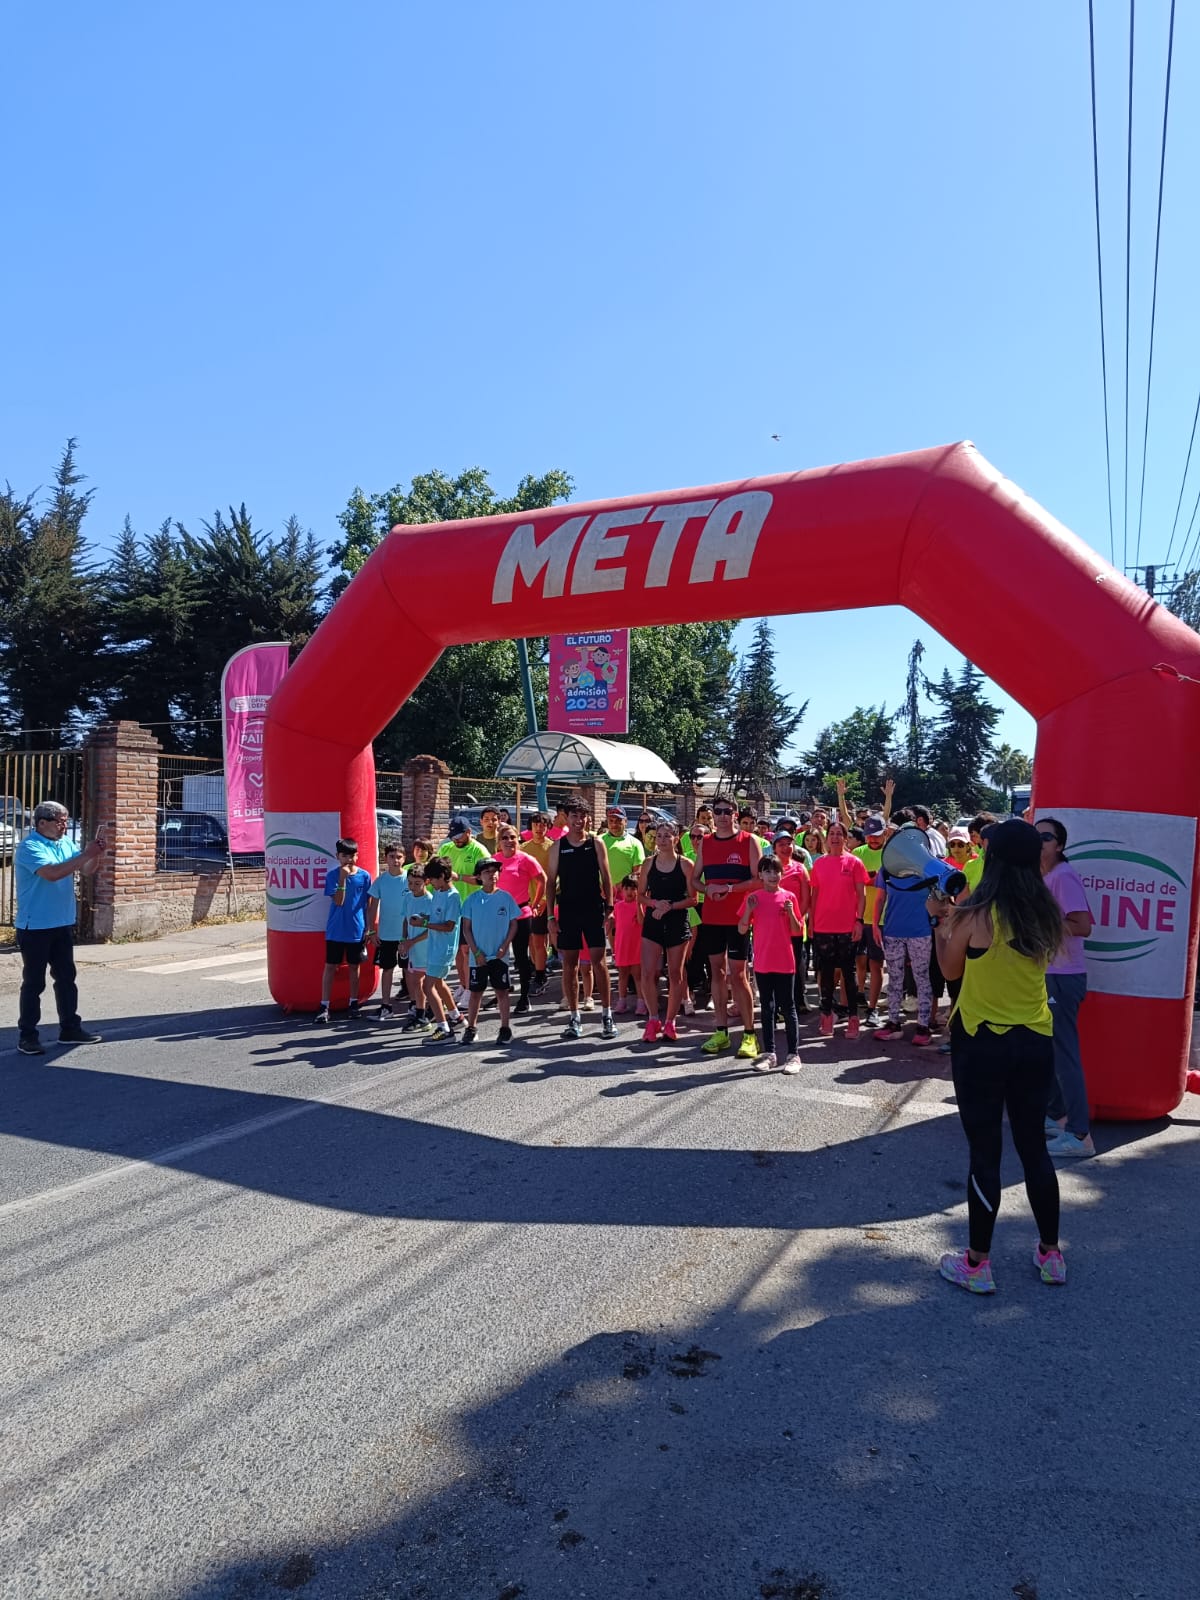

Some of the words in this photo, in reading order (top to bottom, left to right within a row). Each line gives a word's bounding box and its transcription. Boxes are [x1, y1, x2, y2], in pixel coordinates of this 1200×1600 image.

[492, 491, 773, 604] META
[566, 636, 577, 645] EL
[578, 634, 612, 645] FUTURO
[567, 686, 607, 697] admisión
[566, 698, 608, 710] 2026
[314, 856, 328, 865] de
[1080, 875, 1155, 894] cipalidad
[1160, 882, 1177, 895] de
